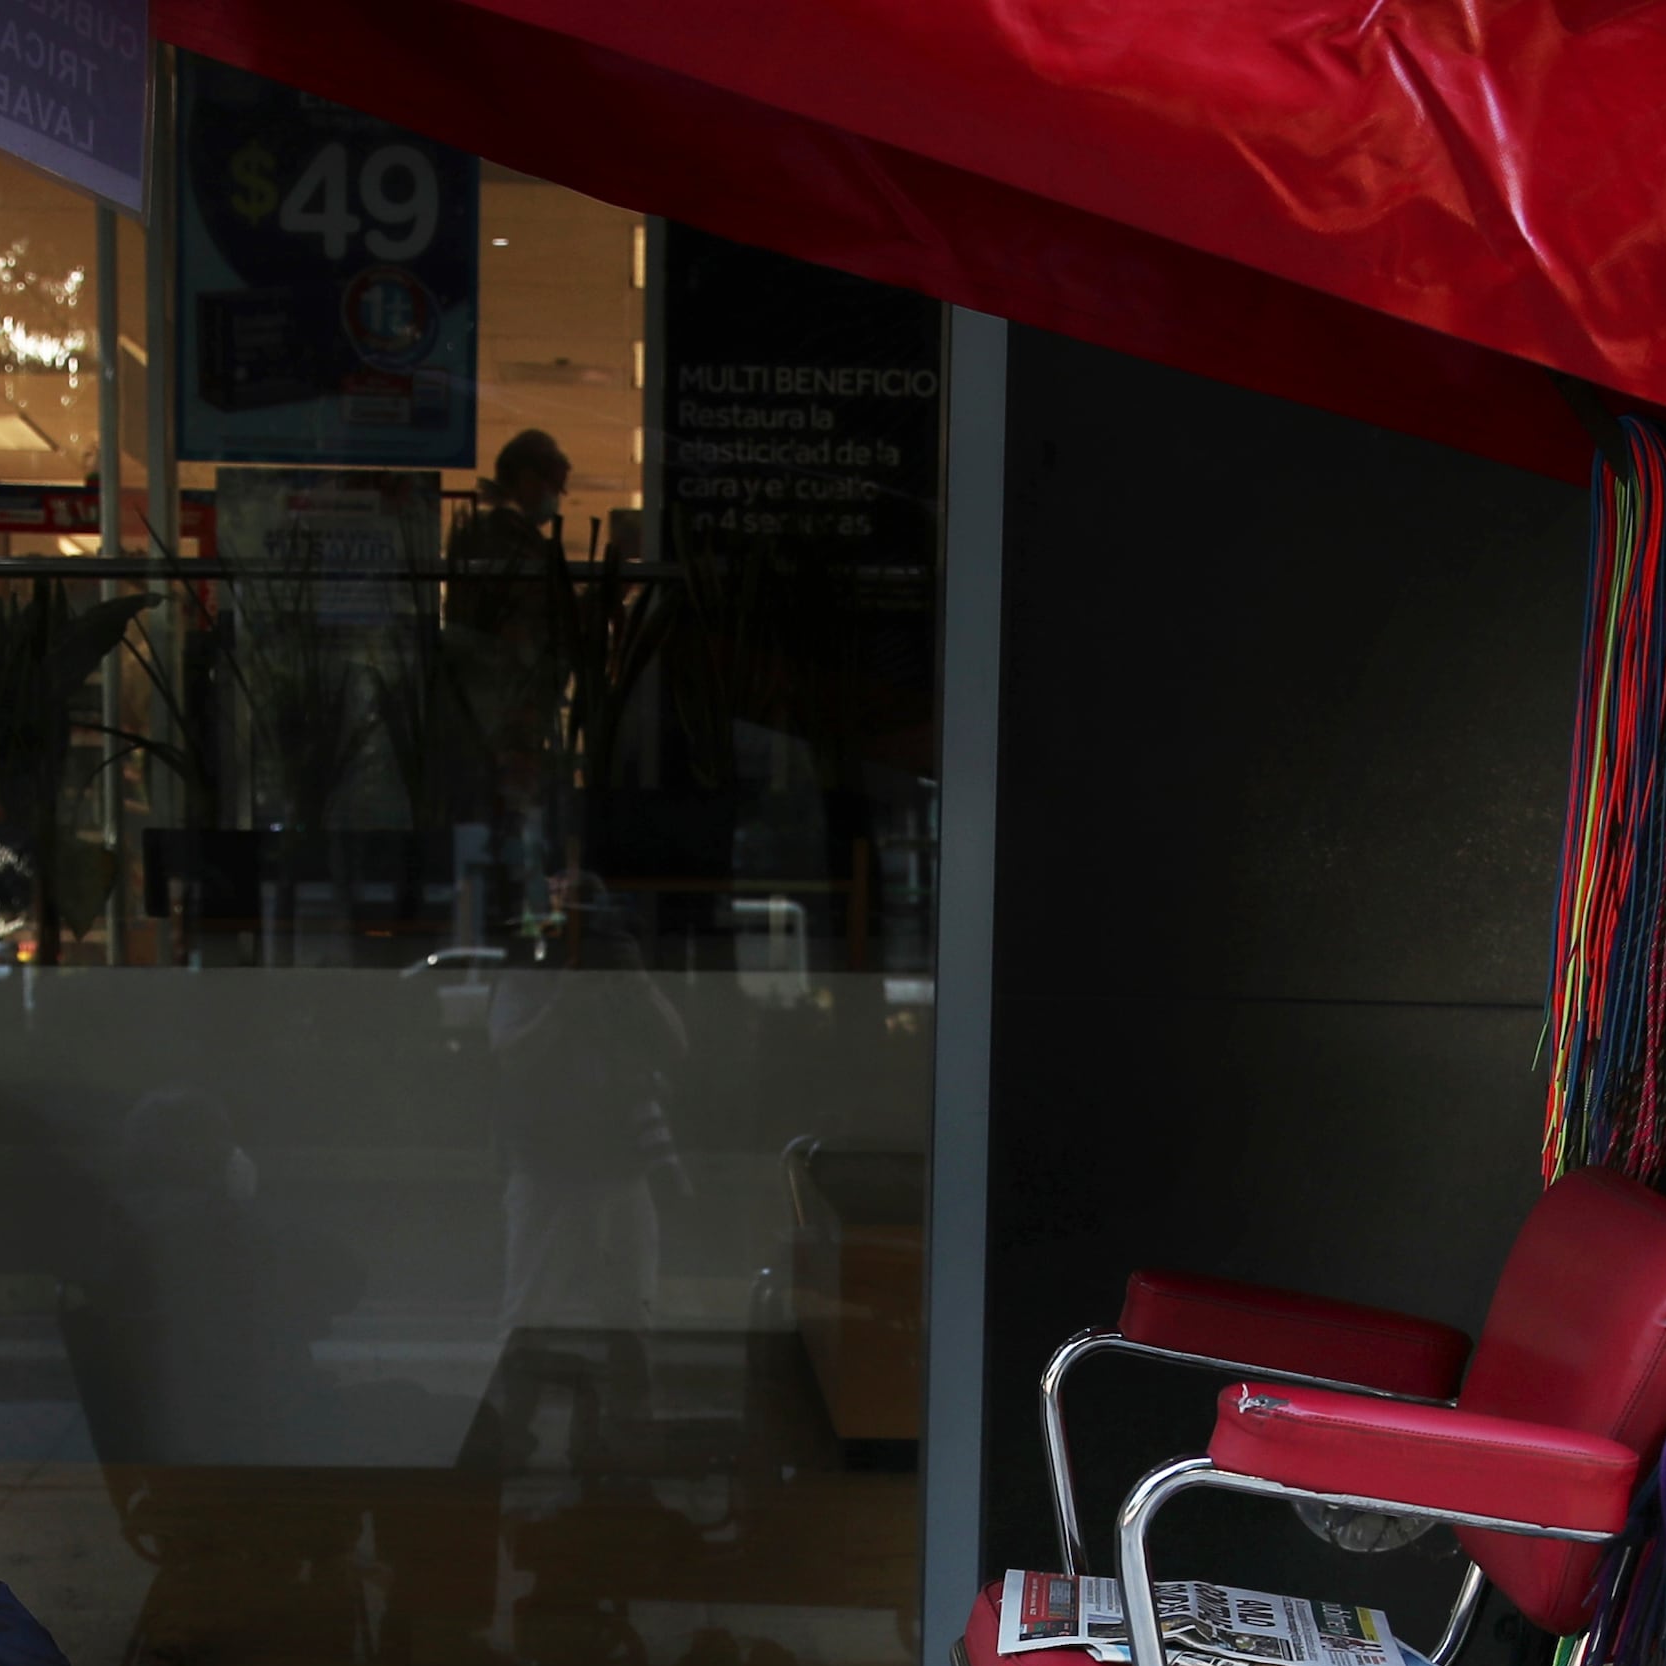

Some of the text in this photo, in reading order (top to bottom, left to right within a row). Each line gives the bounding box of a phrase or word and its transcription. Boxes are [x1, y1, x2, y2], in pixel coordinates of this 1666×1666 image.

[231, 137, 440, 262] $49
[678, 365, 938, 397] MULTI BENEFICIO
[678, 401, 834, 430] Restaura la
[835, 438, 872, 467] de
[677, 476, 739, 499] cara
[742, 478, 758, 505] y
[719, 507, 737, 530] 4
[1235, 1599, 1276, 1628] AMLO
